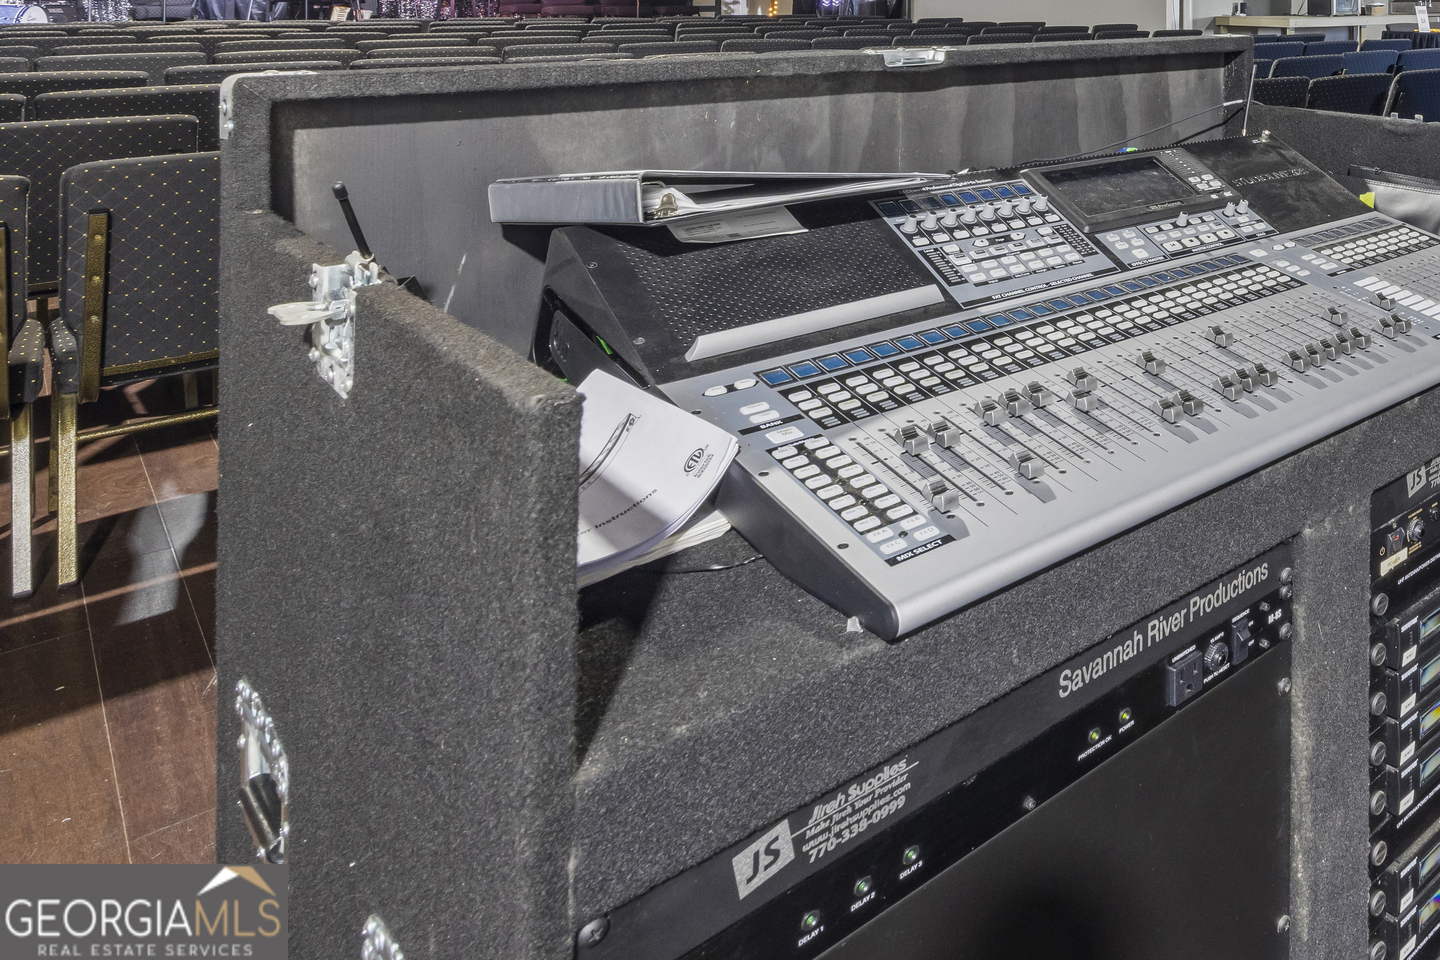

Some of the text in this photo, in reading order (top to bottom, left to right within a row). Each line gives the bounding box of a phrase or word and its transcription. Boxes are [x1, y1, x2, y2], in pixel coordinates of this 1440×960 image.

[760, 420, 783, 429] BANK
[1411, 467, 1423, 491] JS
[594, 488, 658, 529] Instructions
[896, 540, 943, 562] MIX SELECT
[1059, 562, 1269, 698] Savannah River Productions
[1118, 720, 1135, 734] POWER
[1078, 739, 1104, 761] PROTECTION
[809, 759, 907, 825] Jireh Supplies
[802, 782, 911, 853] www.jirehsupplies.com
[804, 773, 909, 839] Make Jireh Your Provider
[808, 795, 907, 863] 770-338-0999
[745, 834, 781, 885] JS
[899, 863, 918, 880] DELAY
[851, 895, 871, 912] DELAY
[798, 929, 819, 947] DELAY
